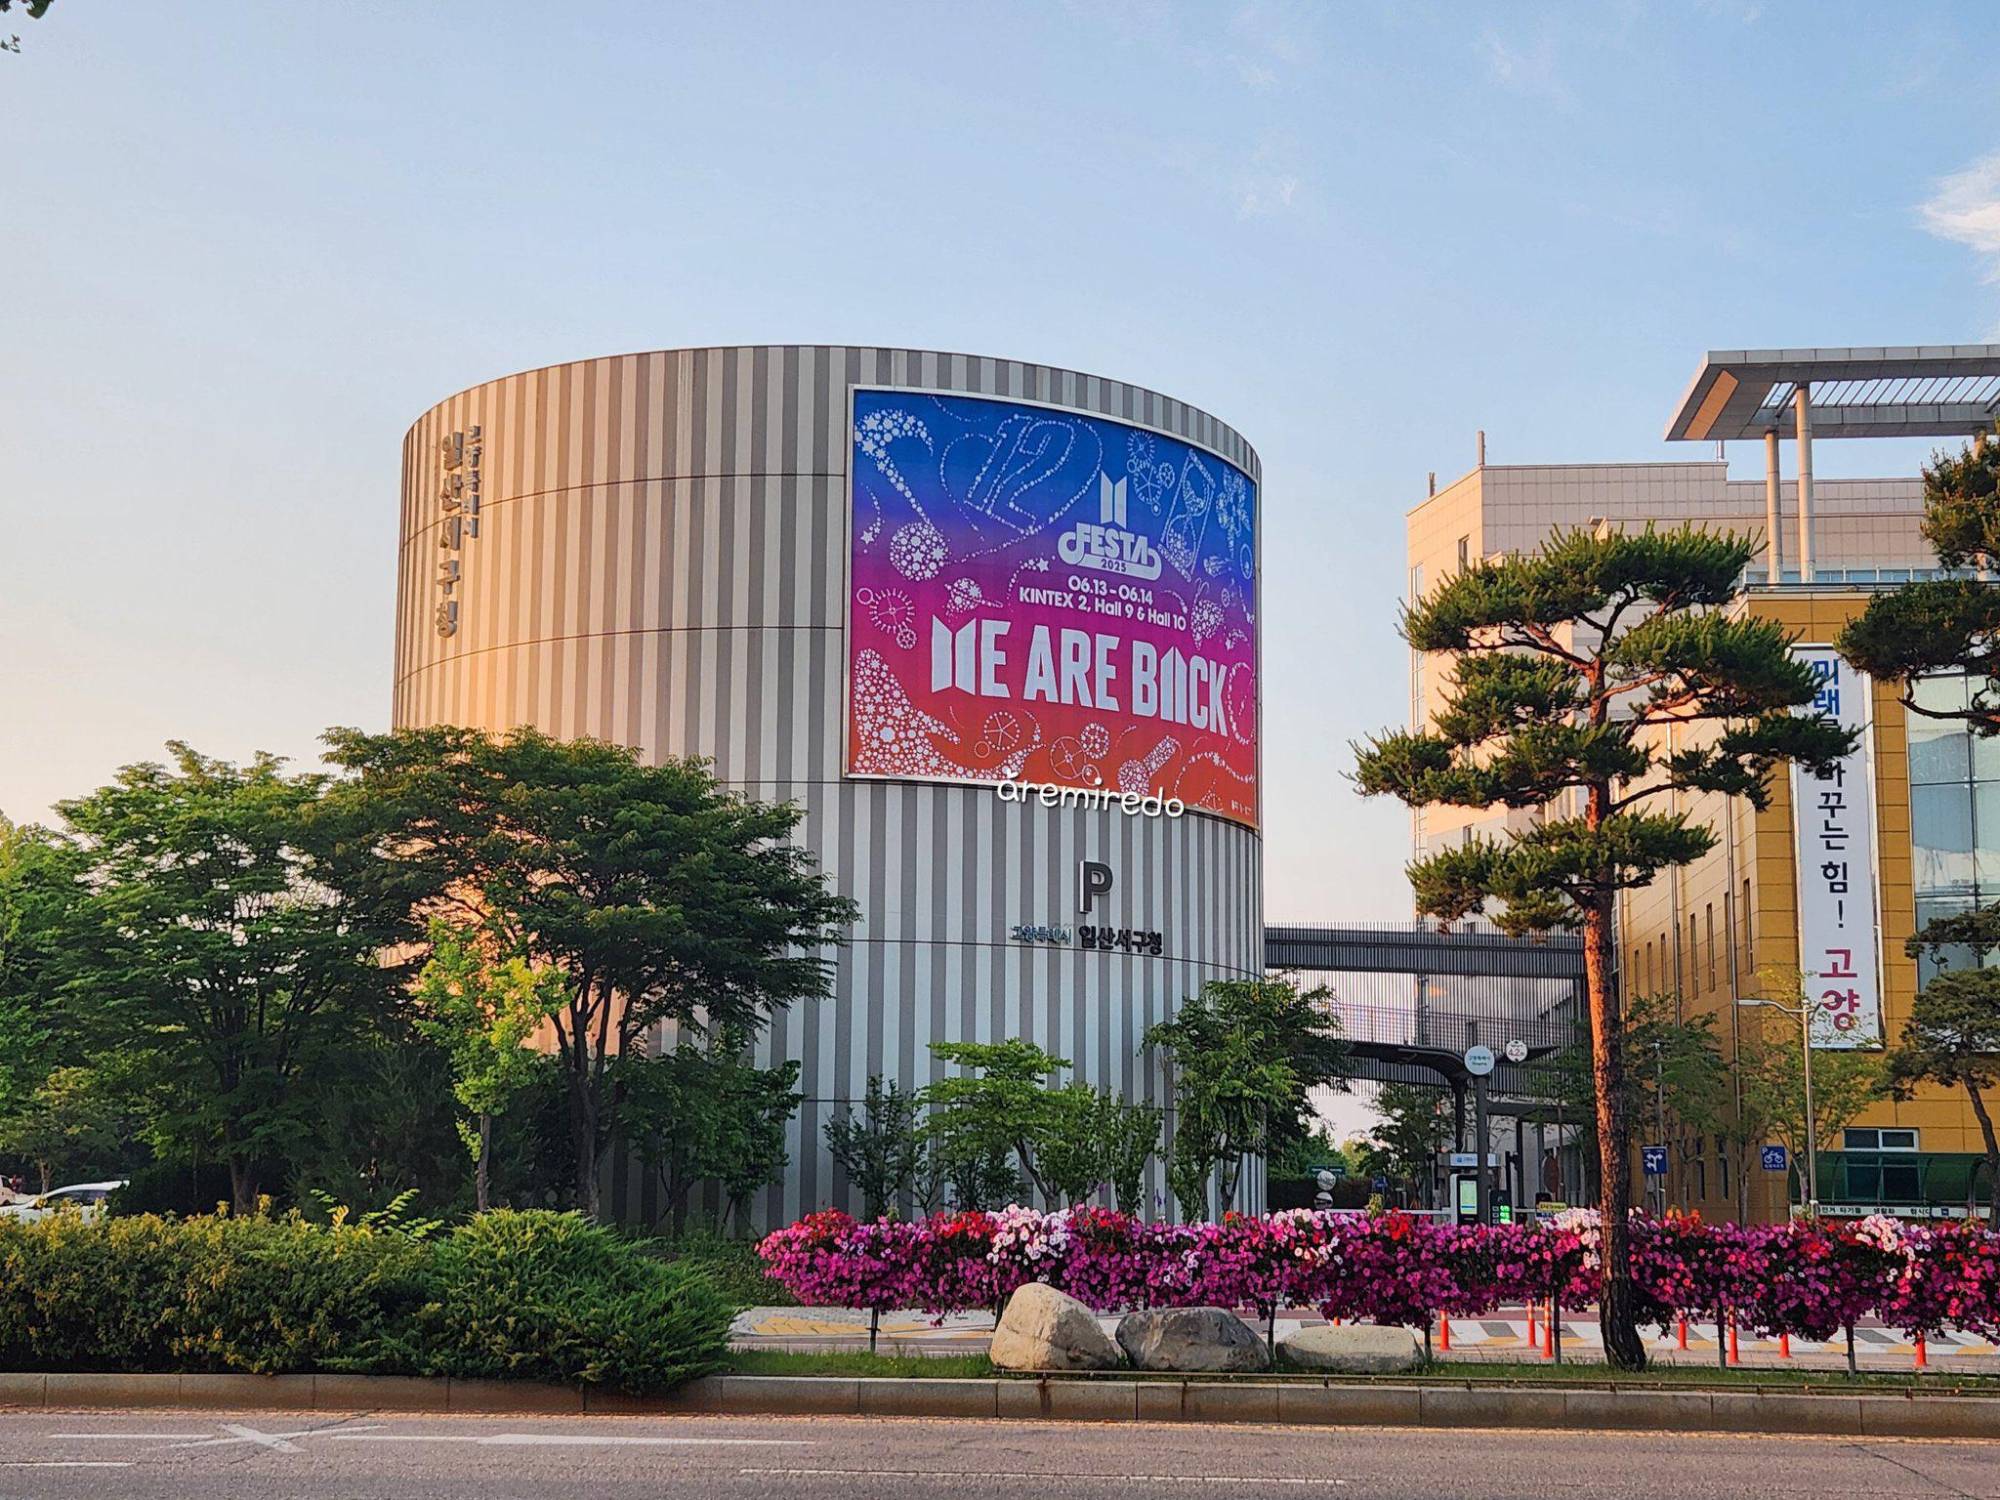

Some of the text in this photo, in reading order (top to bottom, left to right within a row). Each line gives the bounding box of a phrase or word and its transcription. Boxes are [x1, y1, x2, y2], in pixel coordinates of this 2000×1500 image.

[1058, 522, 1162, 581] FESTA
[1100, 558, 1127, 573] 2025
[1019, 586, 1187, 631] KINTEX 2, Hall 9 & Hall 10
[1023, 624, 1120, 712] ARE
[1812, 659, 1840, 729] 미래
[1079, 860, 1114, 914] P
[1820, 861, 1848, 928] 힘!
[1078, 925, 1163, 956] 일산서구청
[1819, 949, 1861, 1031] 고양
